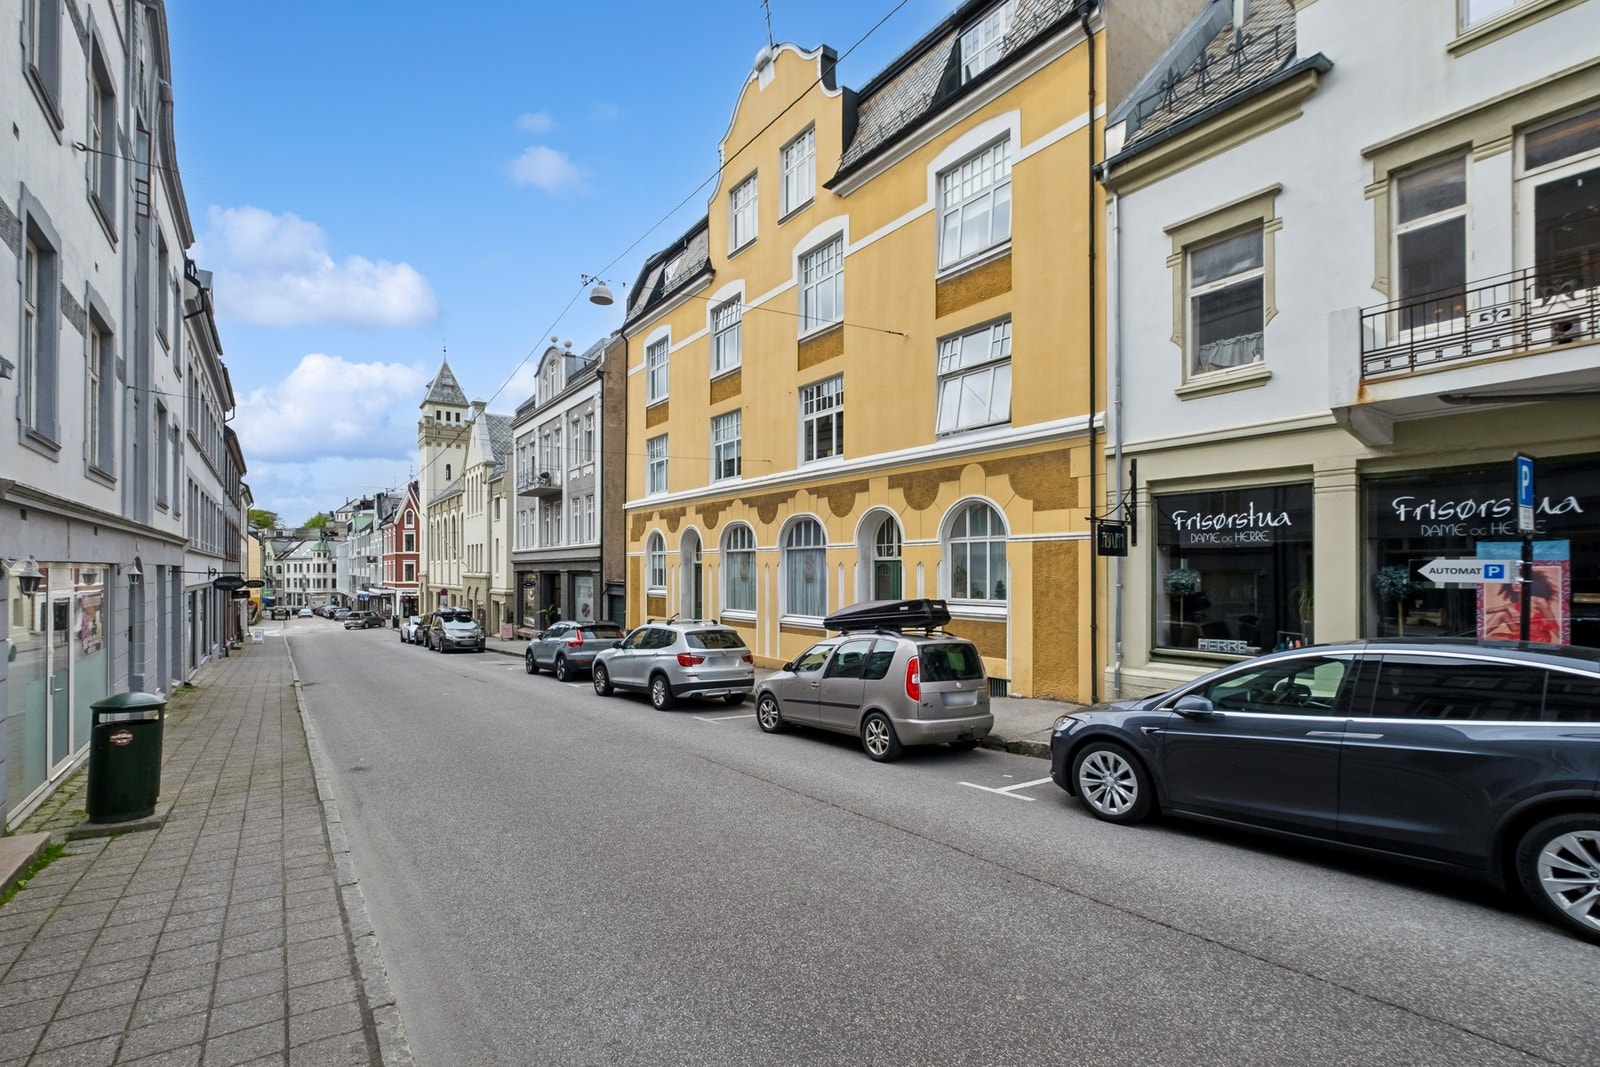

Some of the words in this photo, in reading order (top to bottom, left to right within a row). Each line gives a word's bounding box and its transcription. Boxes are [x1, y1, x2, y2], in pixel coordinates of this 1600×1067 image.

[1521, 465, 1530, 500] P
[1172, 501, 1292, 531] Frisørstua
[1392, 496, 1584, 522] Frisørsua
[1190, 532, 1220, 543] DAME
[1234, 530, 1269, 542] HERRE
[1421, 522, 1467, 537] DAME
[1491, 520, 1547, 536] HEE
[1428, 567, 1482, 575] AUTOMAT
[1488, 566, 1500, 577] P
[1198, 638, 1247, 652] HERRE
